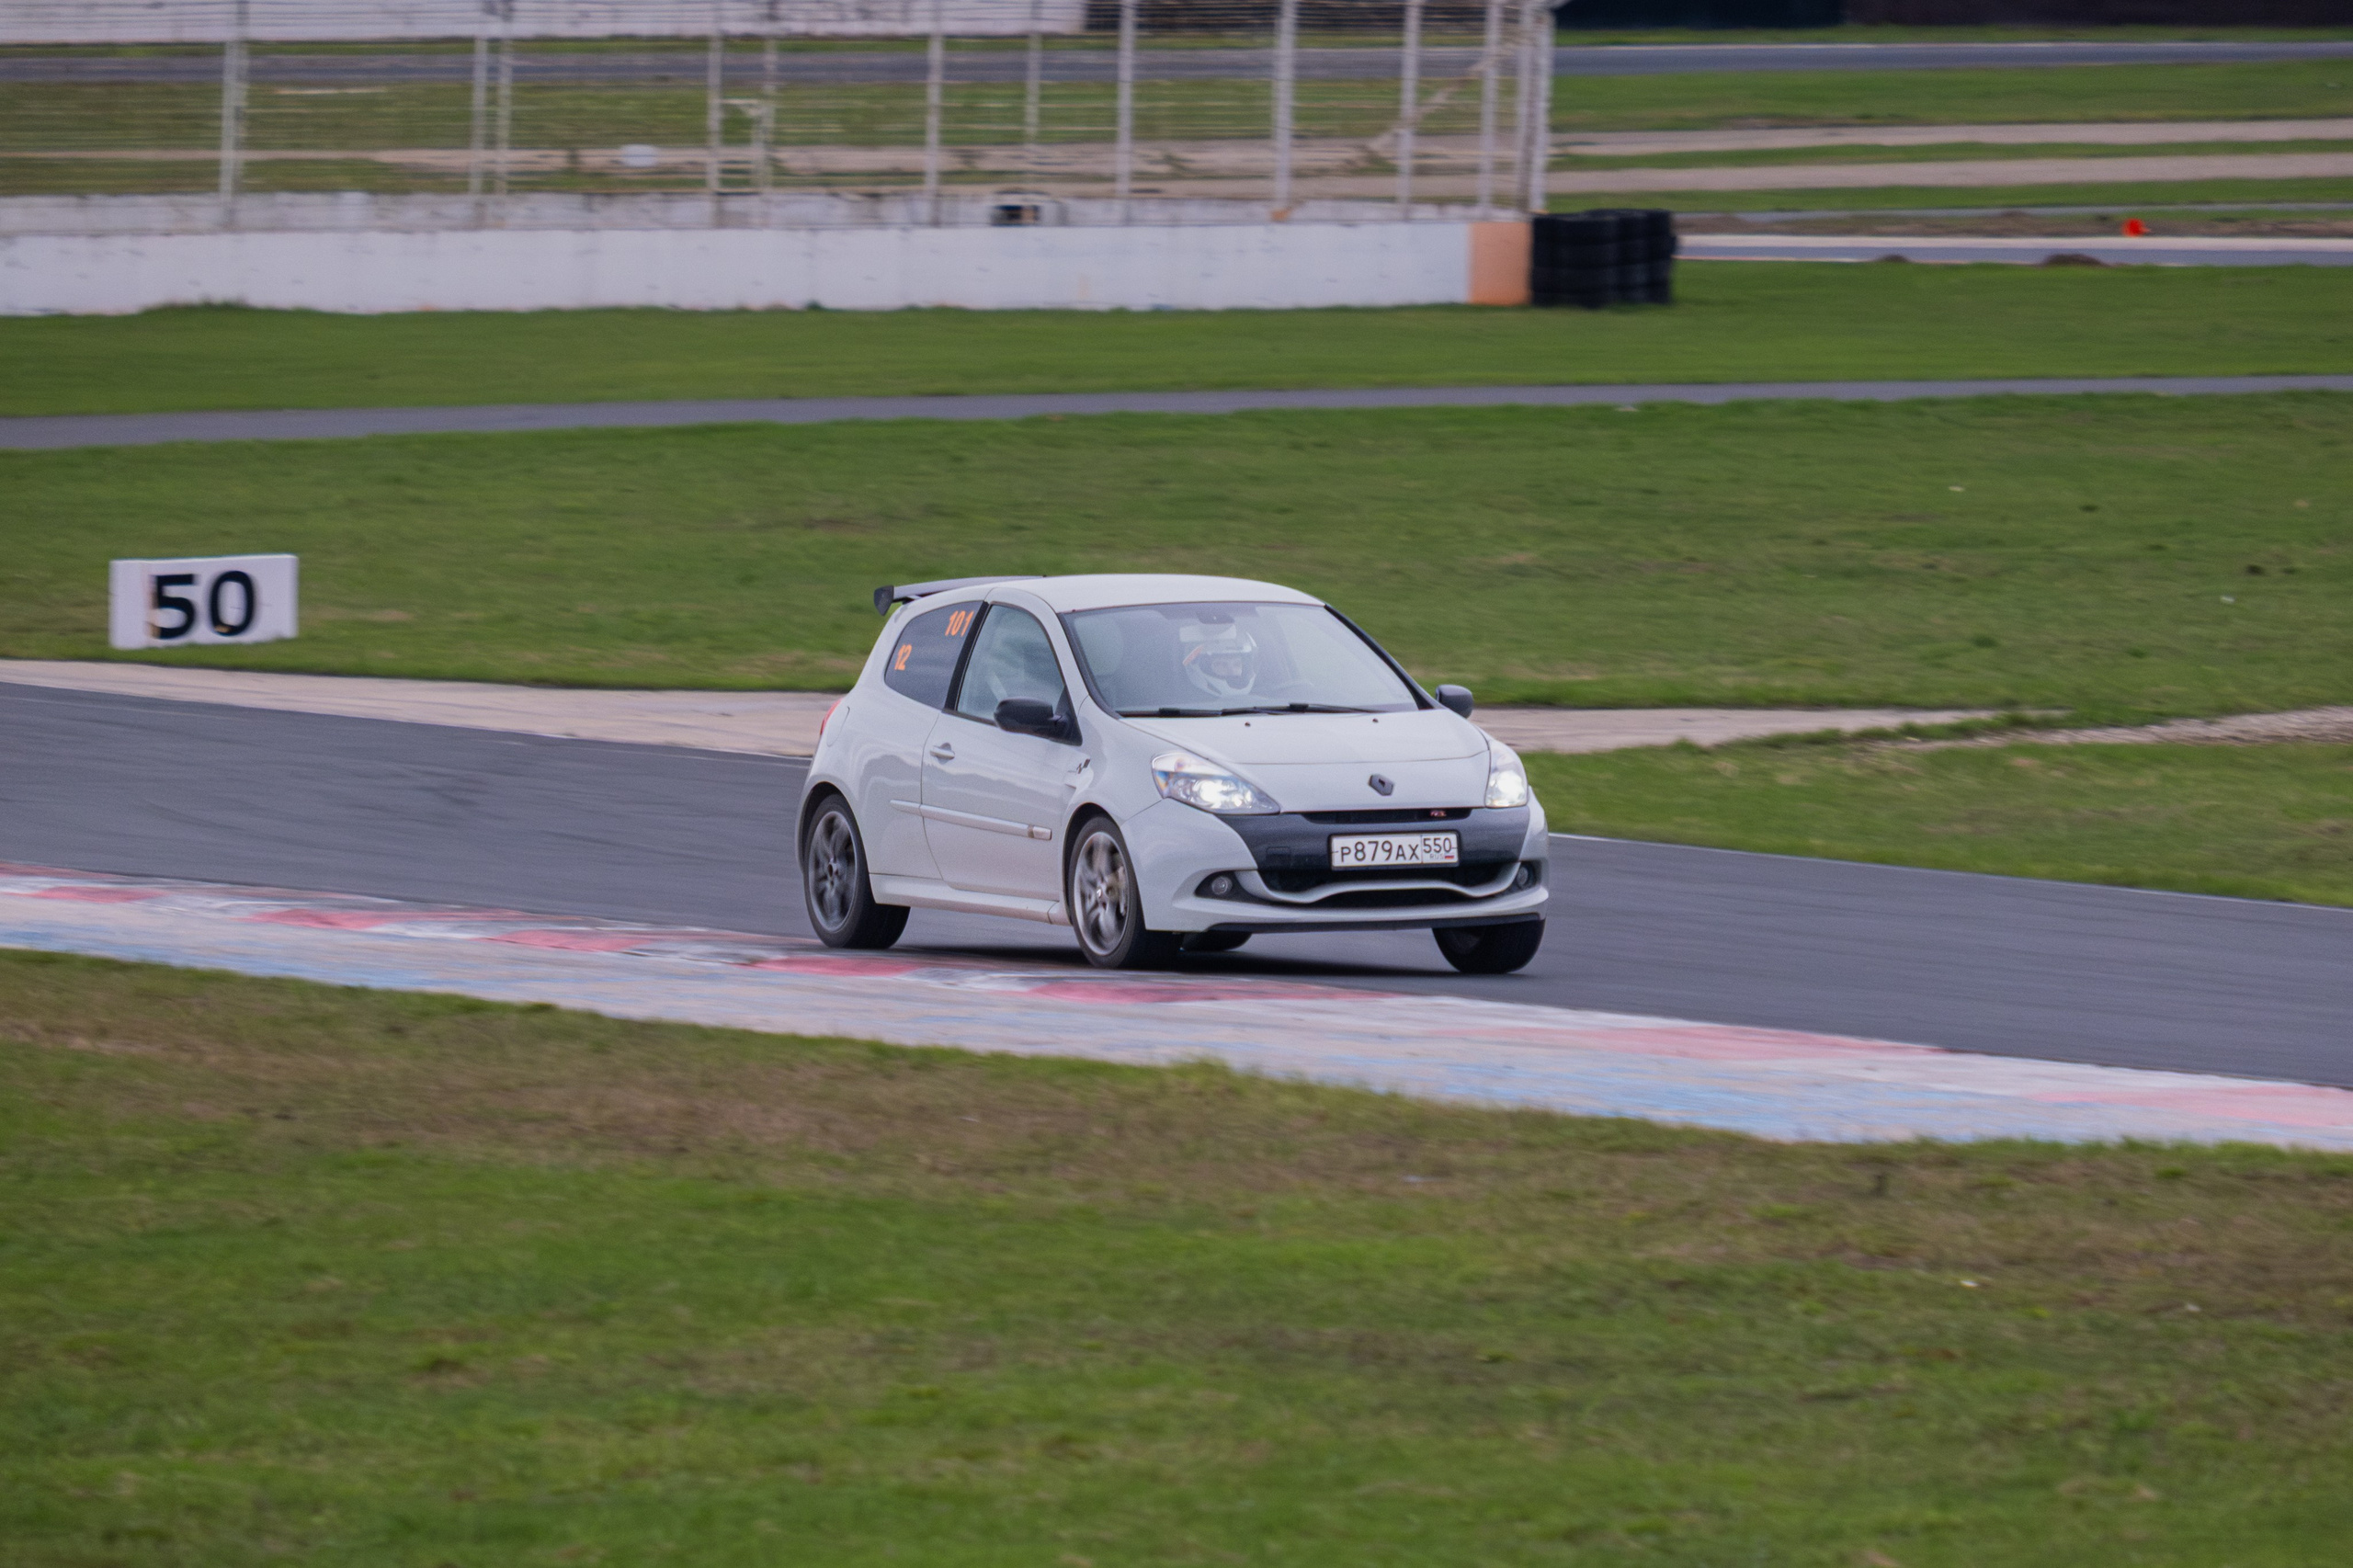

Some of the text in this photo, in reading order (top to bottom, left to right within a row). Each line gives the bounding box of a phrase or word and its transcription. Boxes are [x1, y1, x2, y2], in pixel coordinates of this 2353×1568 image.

[149, 570, 256, 639] 50
[945, 610, 974, 637] 101
[894, 643, 913, 671] 12
[1423, 837, 1452, 854] 550
